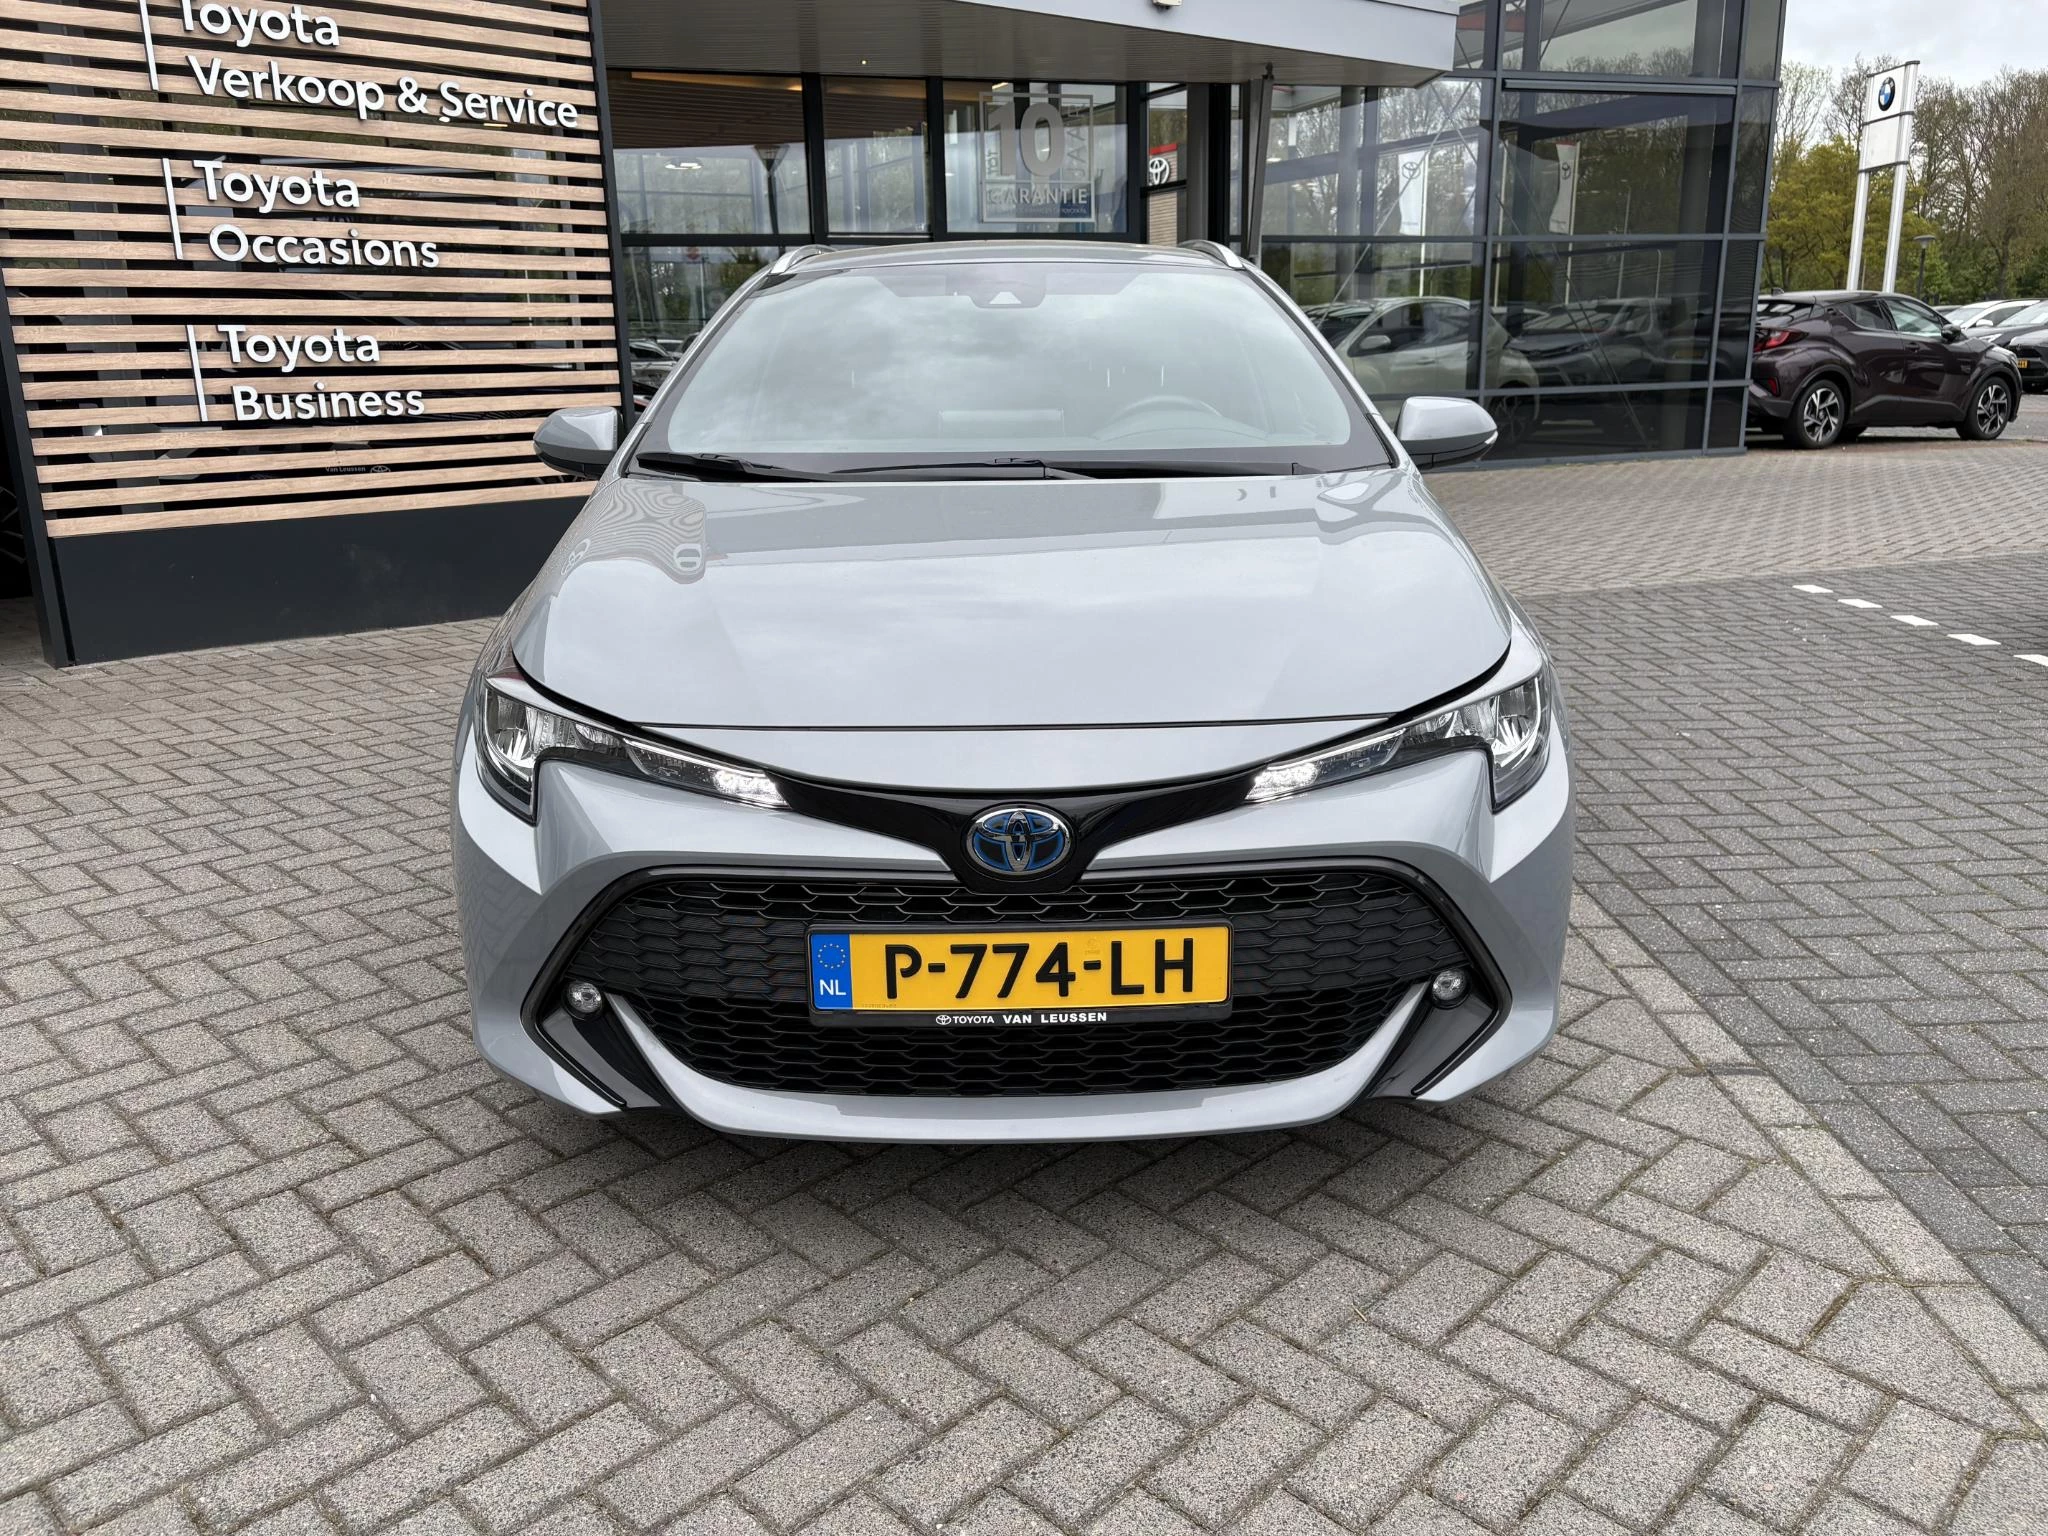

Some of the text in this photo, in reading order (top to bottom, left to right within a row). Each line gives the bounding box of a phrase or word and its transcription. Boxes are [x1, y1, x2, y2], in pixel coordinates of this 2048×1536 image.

[179, 0, 340, 47] Toyota
[185, 55, 579, 128] Verkoop & Service
[987, 101, 1065, 177] 10
[193, 159, 361, 213] Toyota
[989, 188, 1088, 205] GARANTIE
[208, 223, 440, 269] Occasions
[218, 324, 381, 372] Toyota
[231, 382, 425, 423] Business
[819, 979, 847, 996] NL
[885, 937, 1194, 999] P-774-LH
[953, 1012, 1107, 1024] TOYOTA VAN LEUSSEN
